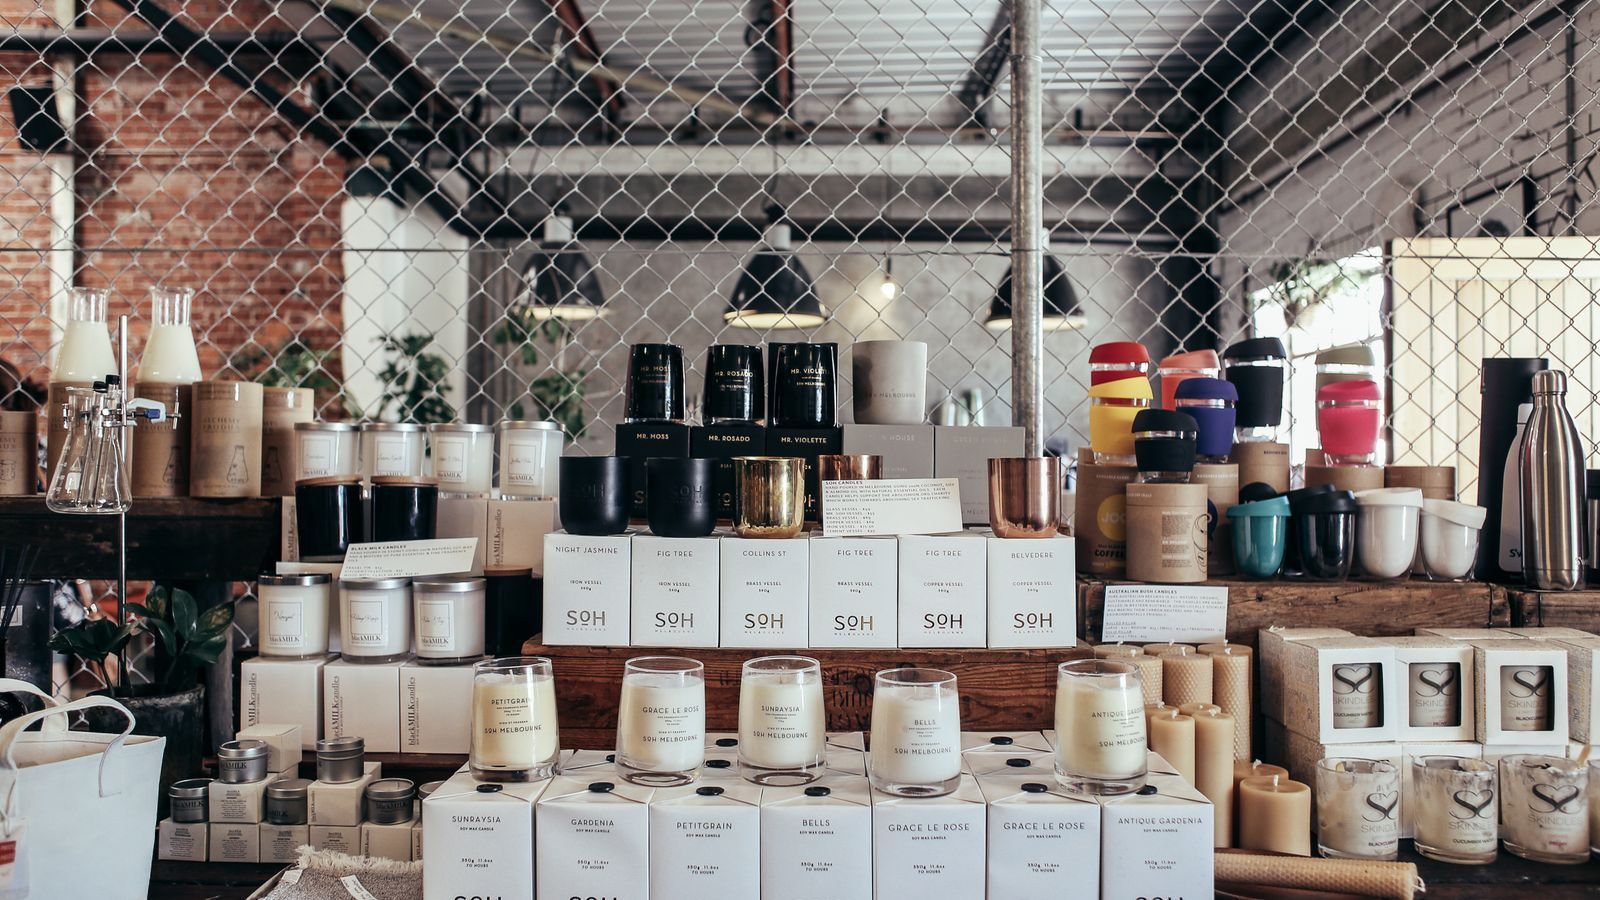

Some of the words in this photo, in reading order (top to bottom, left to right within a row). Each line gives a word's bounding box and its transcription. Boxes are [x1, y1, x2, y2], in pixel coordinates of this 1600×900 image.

[555, 546, 580, 554] NIGHT
[583, 547, 619, 555] JASMINE
[837, 549, 851, 557] FIG
[855, 549, 874, 557] TREE
[1094, 547, 1126, 559] COFFE
[1011, 551, 1054, 559] BELVEDERE
[642, 706, 670, 714] GRACE
[683, 705, 700, 713] ROSE
[499, 724, 542, 734] MELBOURNE
[659, 735, 698, 743] MELBOURNE
[911, 747, 952, 755] MELBOURNE
[452, 815, 502, 824] SUNRAYSIA
[571, 819, 615, 827] GARDENIA
[802, 819, 831, 827] BELLS
[1118, 817, 1156, 825] ANTIQUE
[1158, 817, 1203, 825] GARDENIA
[676, 822, 732, 830] PETITGRAIN
[888, 823, 923, 832] GRACE
[927, 823, 939, 832] LE
[943, 823, 970, 831] ROSE
[1003, 822, 1038, 830] GRACE
[1042, 822, 1054, 830] LE
[1058, 822, 1085, 830] ROSE
